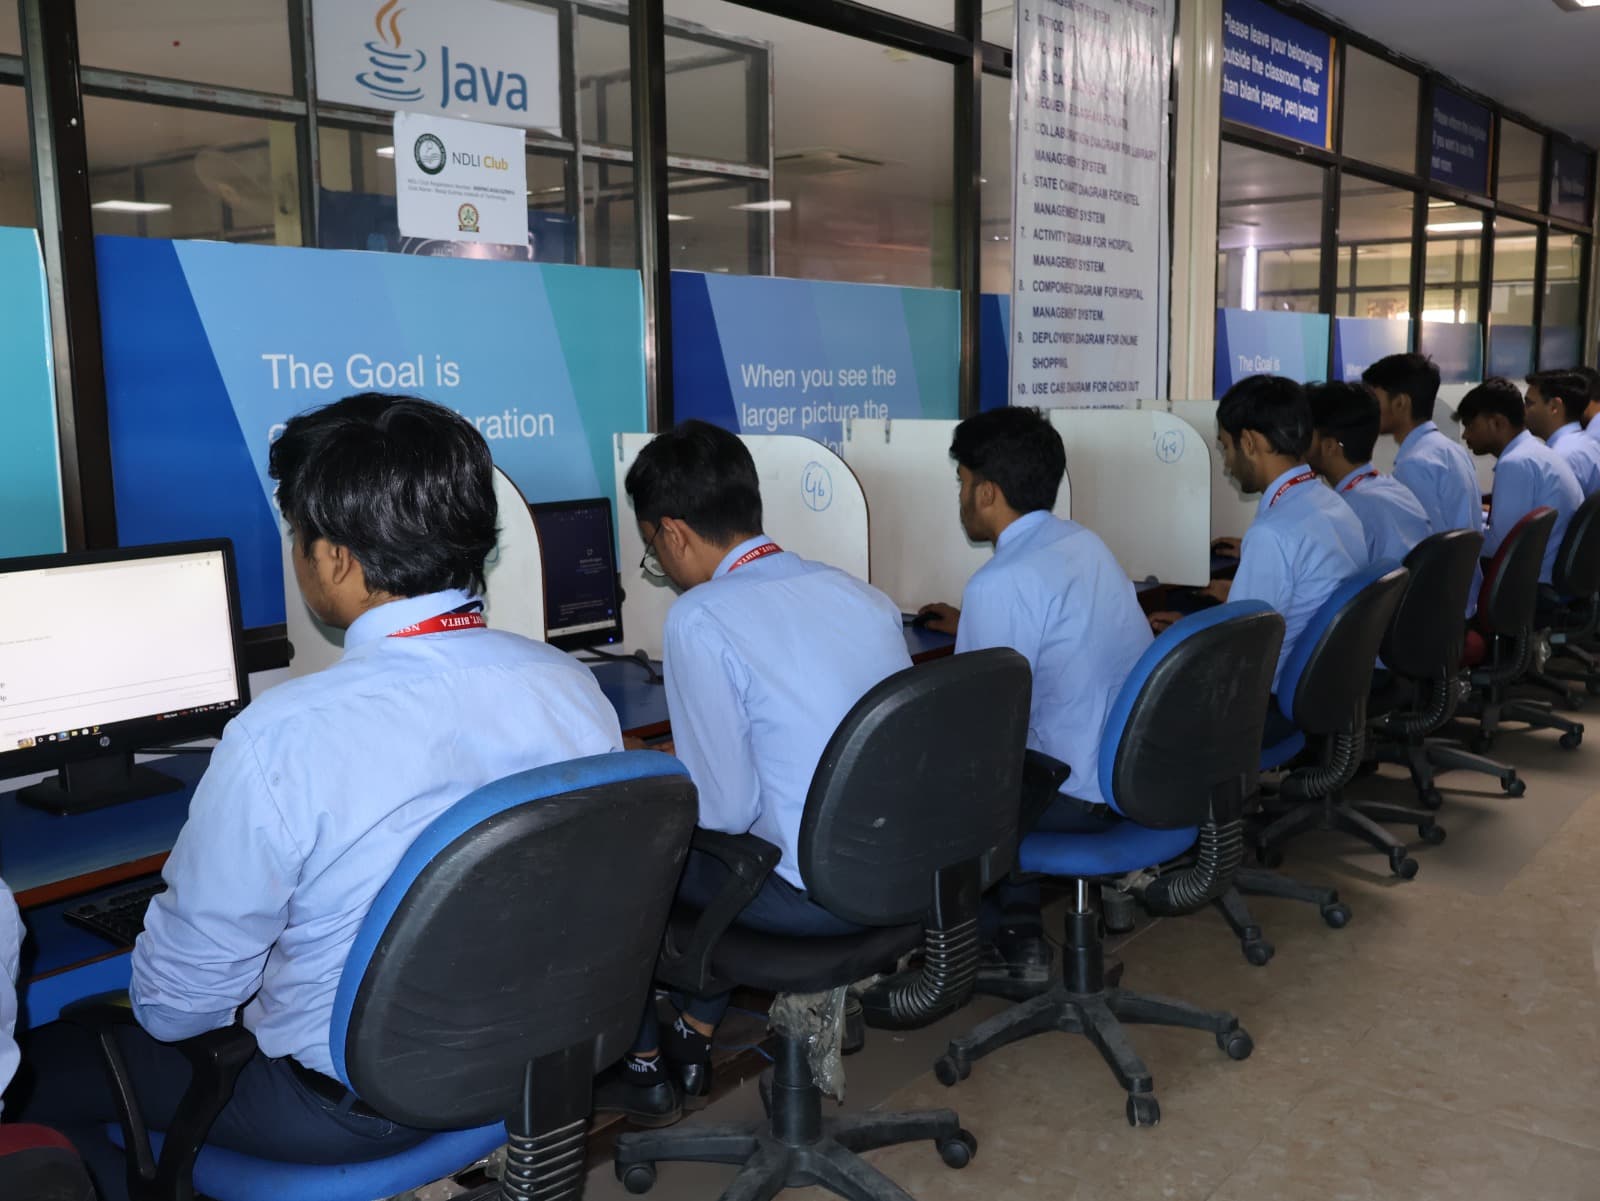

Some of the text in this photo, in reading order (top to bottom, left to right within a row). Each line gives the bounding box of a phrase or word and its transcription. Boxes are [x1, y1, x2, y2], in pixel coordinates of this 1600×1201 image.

[1250, 23, 1270, 48] leave
[1271, 36, 1287, 55] your
[1287, 39, 1323, 74] belongings
[440, 46, 528, 112] Java
[1223, 74, 1239, 96] han
[1240, 80, 1261, 103] blank
[1252, 55, 1265, 76] the
[1303, 76, 1320, 96] other
[452, 151, 481, 168] NDLI
[483, 155, 509, 171] Club
[1034, 175, 1058, 190] STATE
[1109, 190, 1123, 202] FOR
[1033, 228, 1066, 242] ACTIVITY
[1093, 237, 1107, 248] FOR
[1104, 286, 1118, 298] FOR
[1106, 335, 1120, 346] FOR
[261, 354, 460, 389] The Goal is
[741, 364, 897, 393] When you see the
[1032, 383, 1048, 395] USE
[1092, 381, 1107, 393] FOR
[1109, 381, 1127, 393] CHECK
[742, 400, 888, 432] larger picture the
[440, 616, 470, 628] BIHTA
